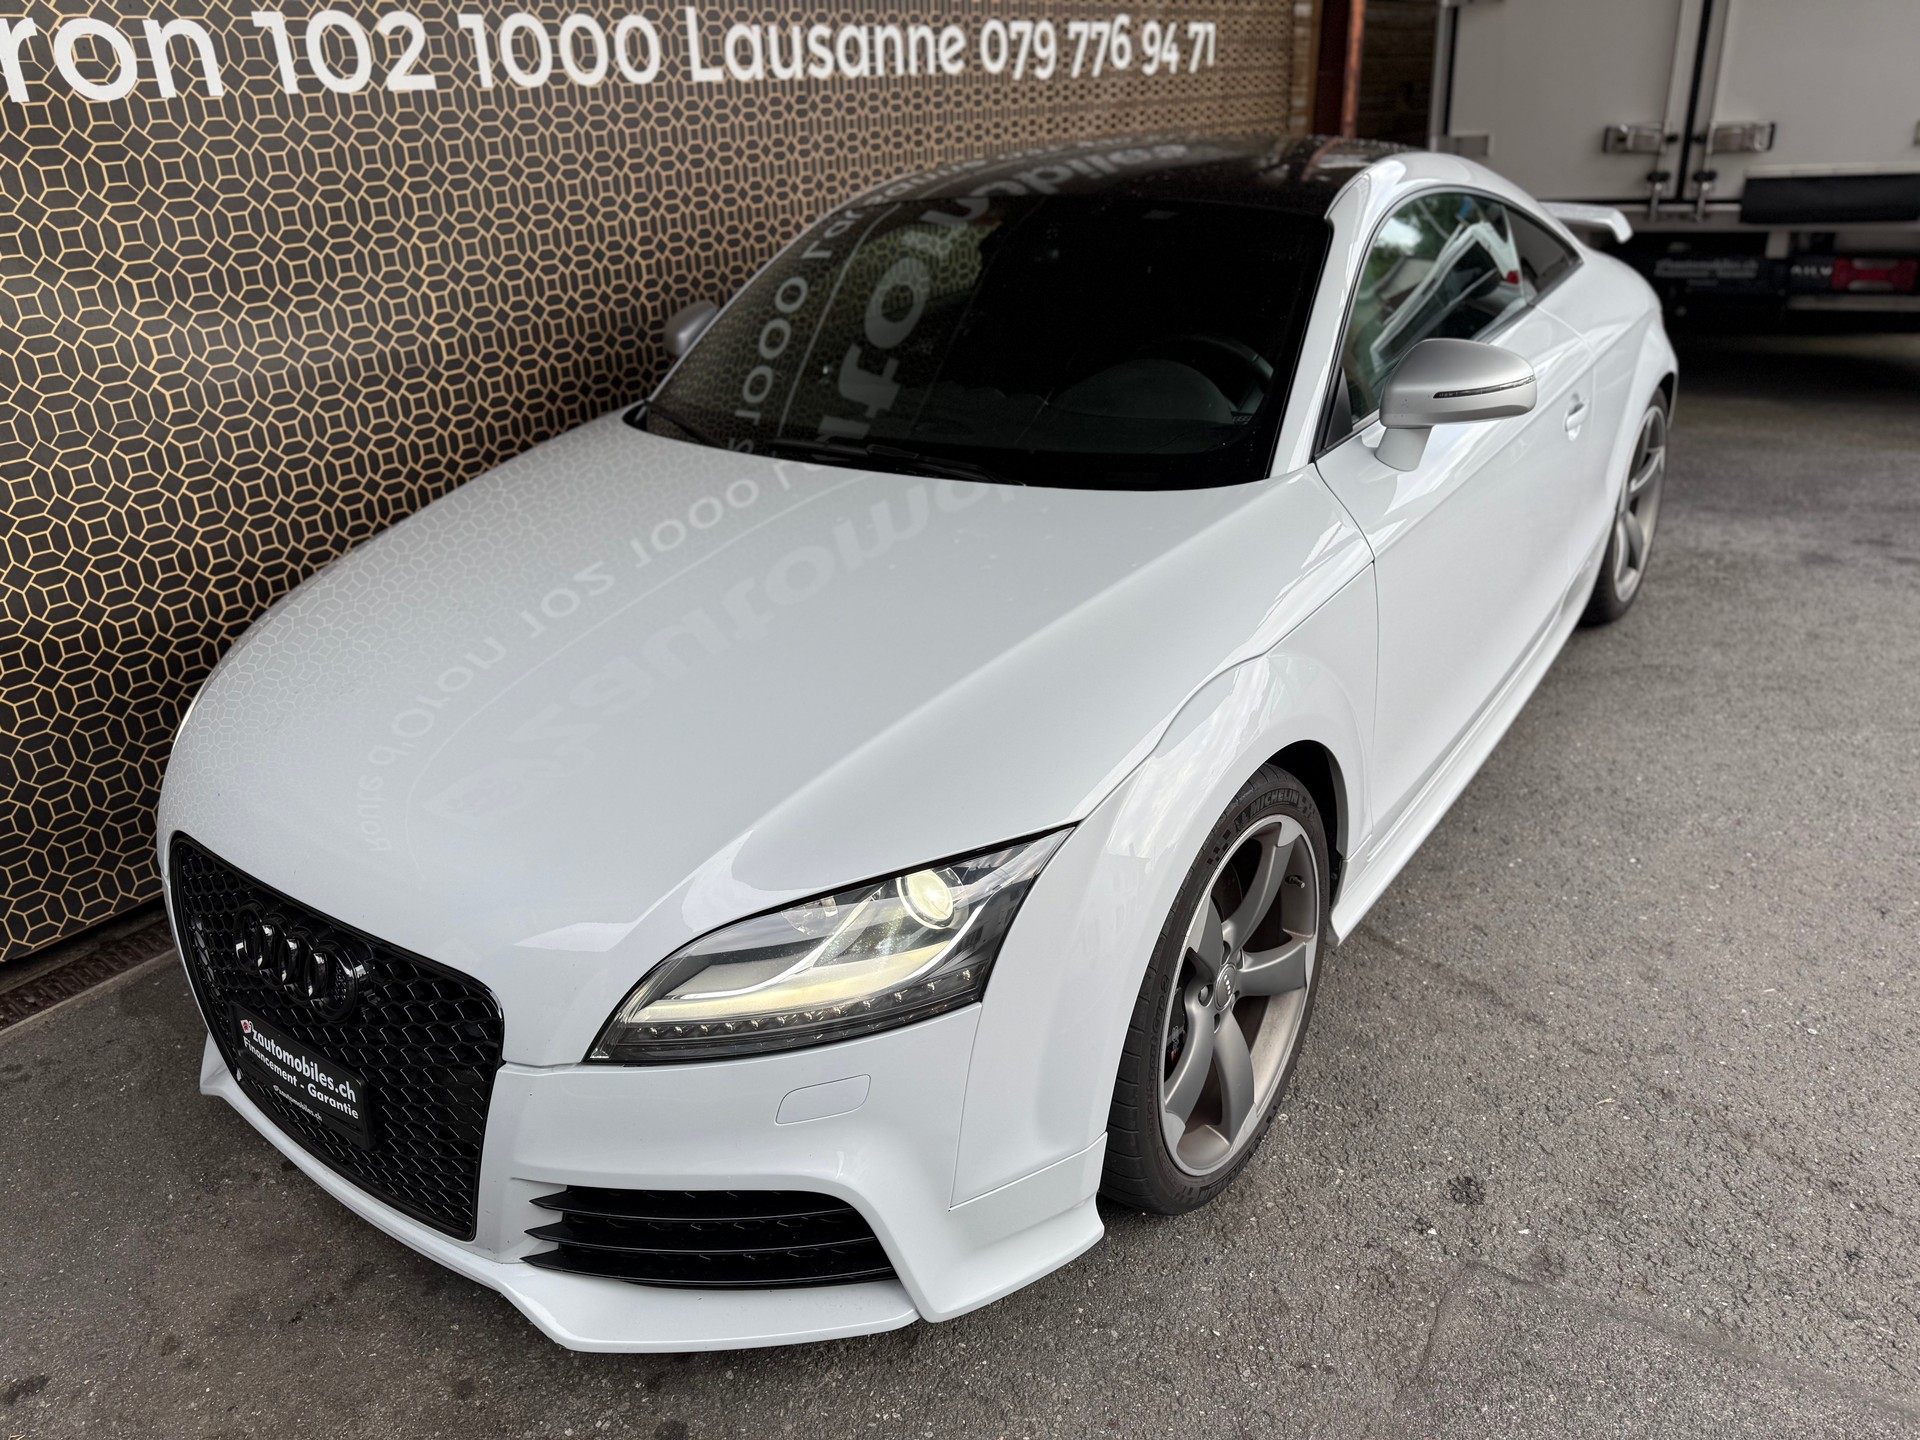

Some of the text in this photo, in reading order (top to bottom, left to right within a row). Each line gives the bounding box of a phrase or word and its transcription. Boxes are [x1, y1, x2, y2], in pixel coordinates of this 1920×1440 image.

[251, 9, 437, 94] 102
[458, 13, 661, 88] 1000
[685, 5, 967, 82] Lausanne
[980, 19, 1057, 80] 079
[1068, 14, 1132, 79] 776
[1141, 22, 1179, 76] 94
[1188, 22, 1217, 73] 71
[1250, 788, 1298, 815] MICHELIN
[243, 1035, 297, 1087] Financement
[307, 1082, 359, 1119] Garantie
